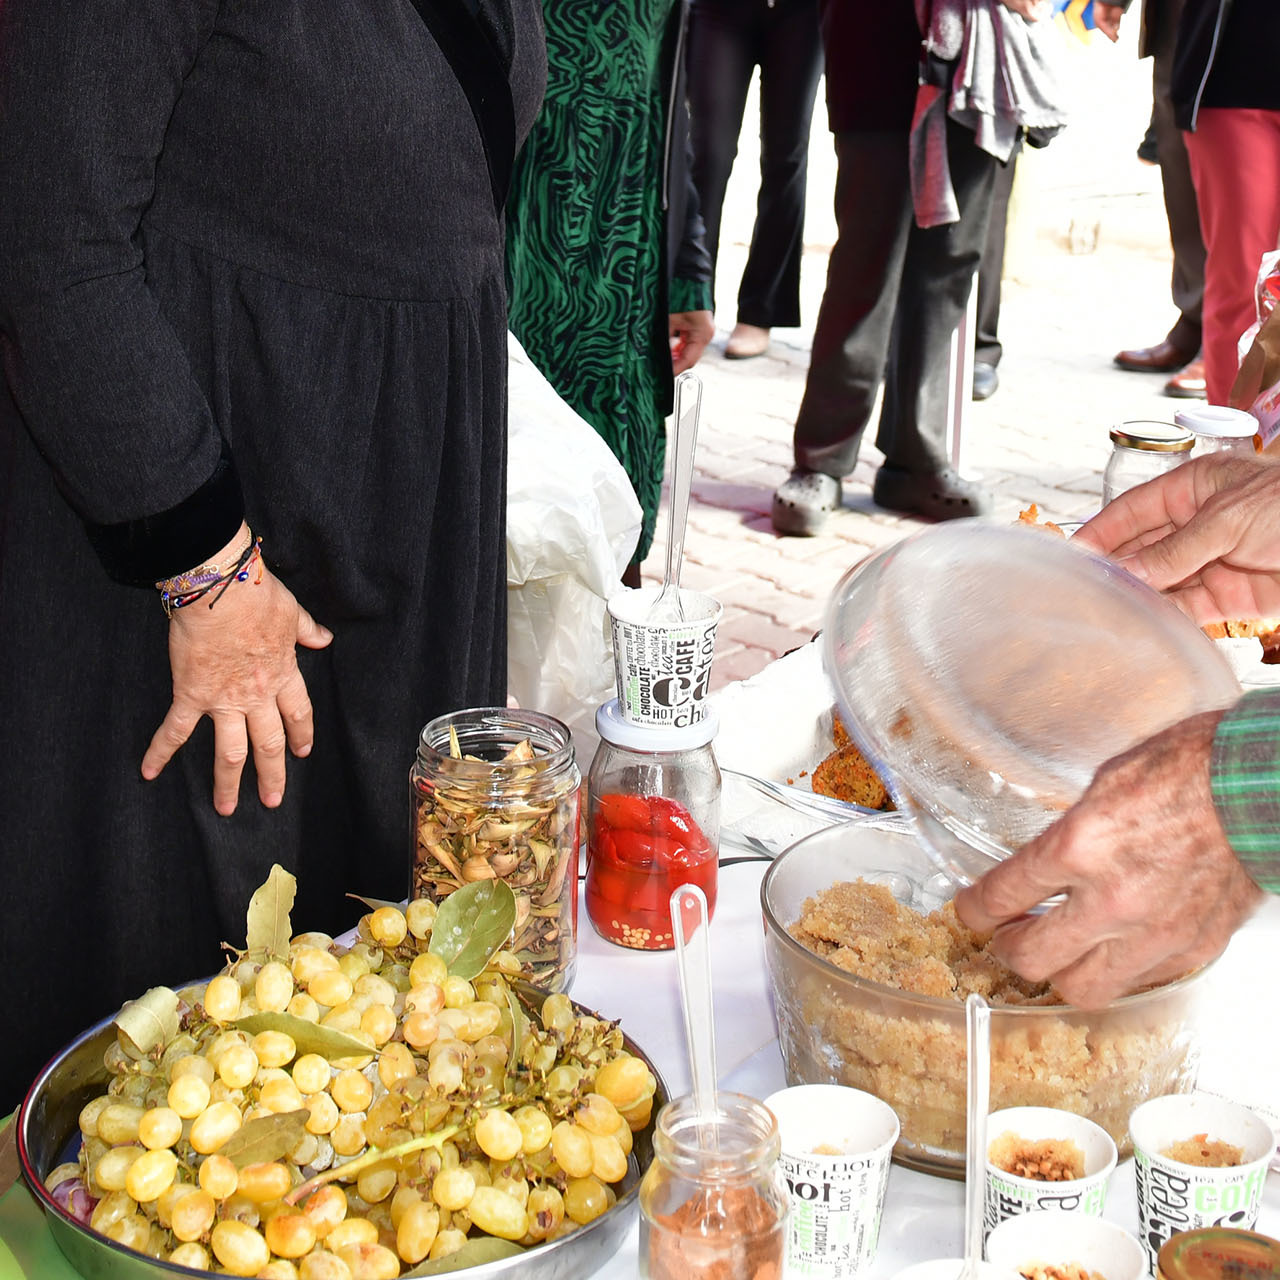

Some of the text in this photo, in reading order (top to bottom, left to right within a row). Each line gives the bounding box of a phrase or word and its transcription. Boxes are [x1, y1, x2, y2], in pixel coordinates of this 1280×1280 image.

[675, 639, 695, 675] CAFE
[640, 667, 651, 716] CHOCOLATE
[652, 708, 674, 720] HOT
[814, 1214, 828, 1256] CHOCOLATE
